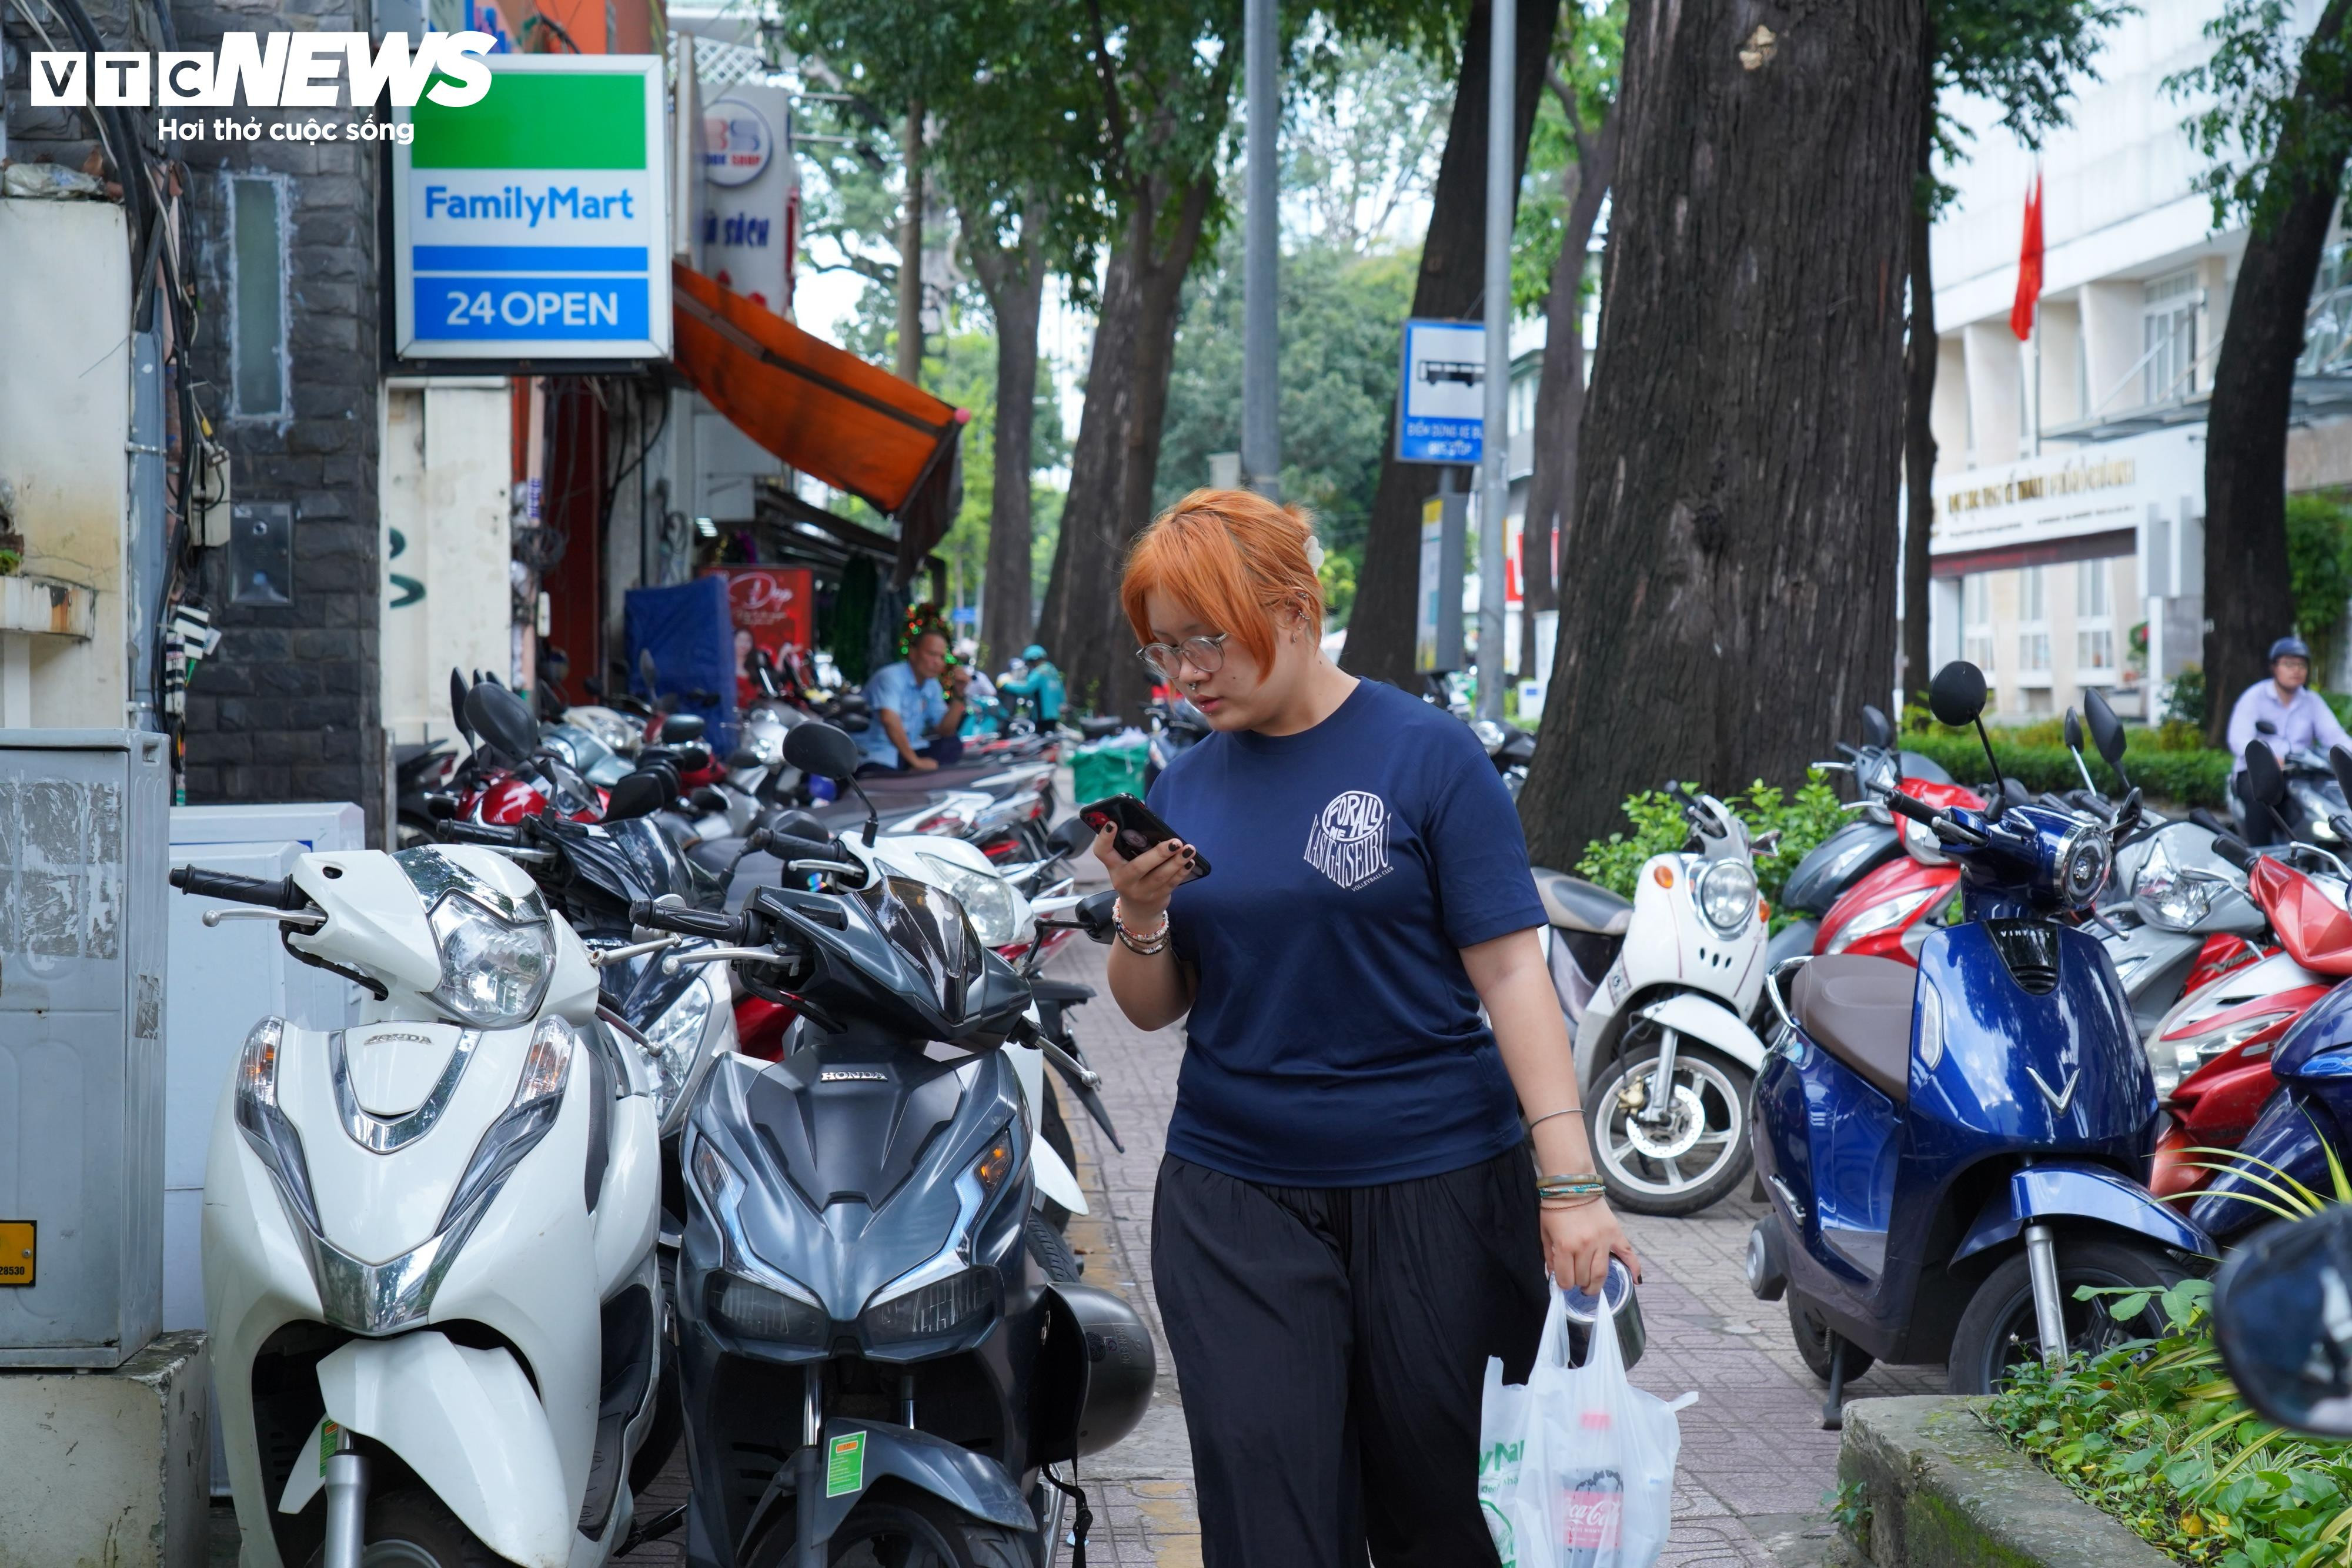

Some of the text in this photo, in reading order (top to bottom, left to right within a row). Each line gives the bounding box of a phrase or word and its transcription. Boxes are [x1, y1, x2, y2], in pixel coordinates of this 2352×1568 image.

[425, 185, 634, 229] FamilyMart
[446, 291, 618, 327] 24 OPEN
[1351, 865, 1395, 892] VOLLEYBALL CLUB
[821, 1071, 889, 1083] HONDA
